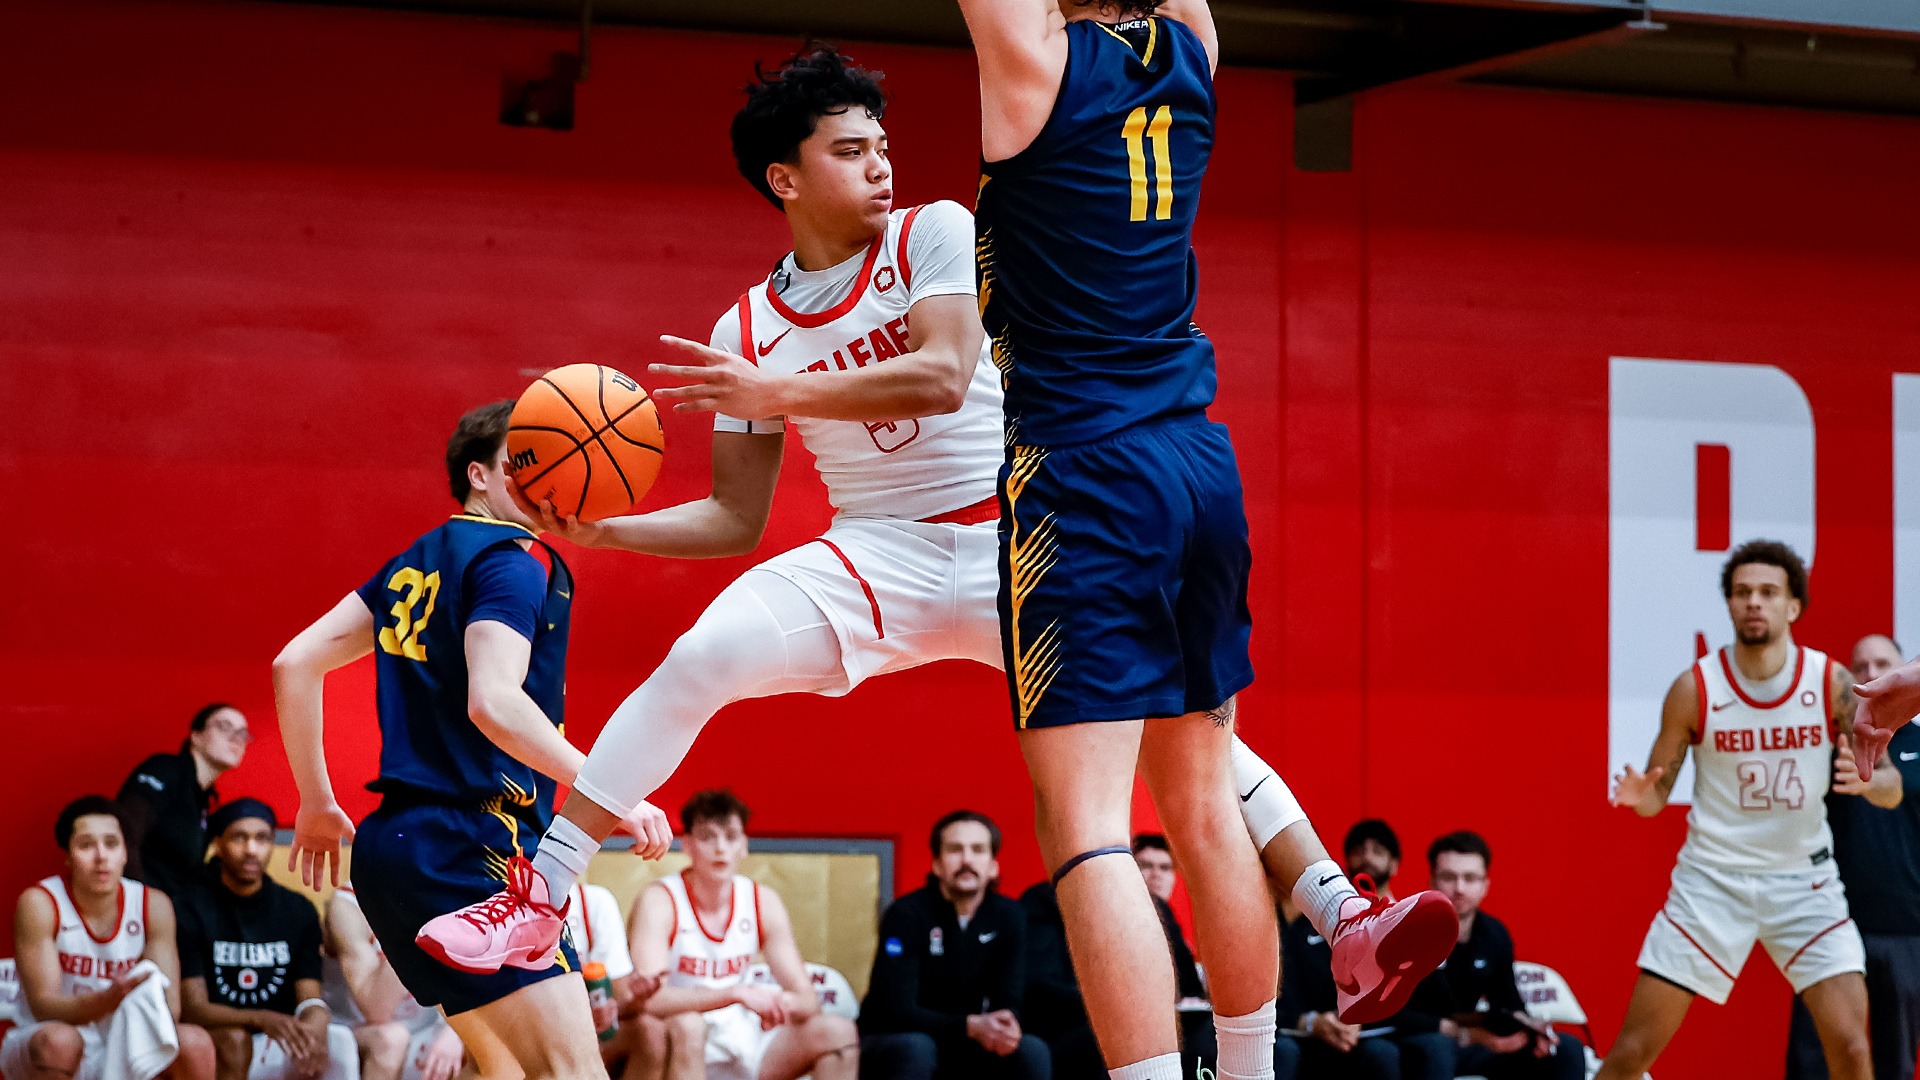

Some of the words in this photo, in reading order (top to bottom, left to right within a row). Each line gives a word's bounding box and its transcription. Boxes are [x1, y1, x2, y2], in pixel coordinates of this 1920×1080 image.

[1114, 20, 1140, 32] NIKE
[1121, 105, 1174, 221] 11
[378, 566, 441, 662] 32
[1714, 728, 1754, 753] RED
[1759, 725, 1822, 751] LEAFS
[1736, 757, 1805, 811] 24
